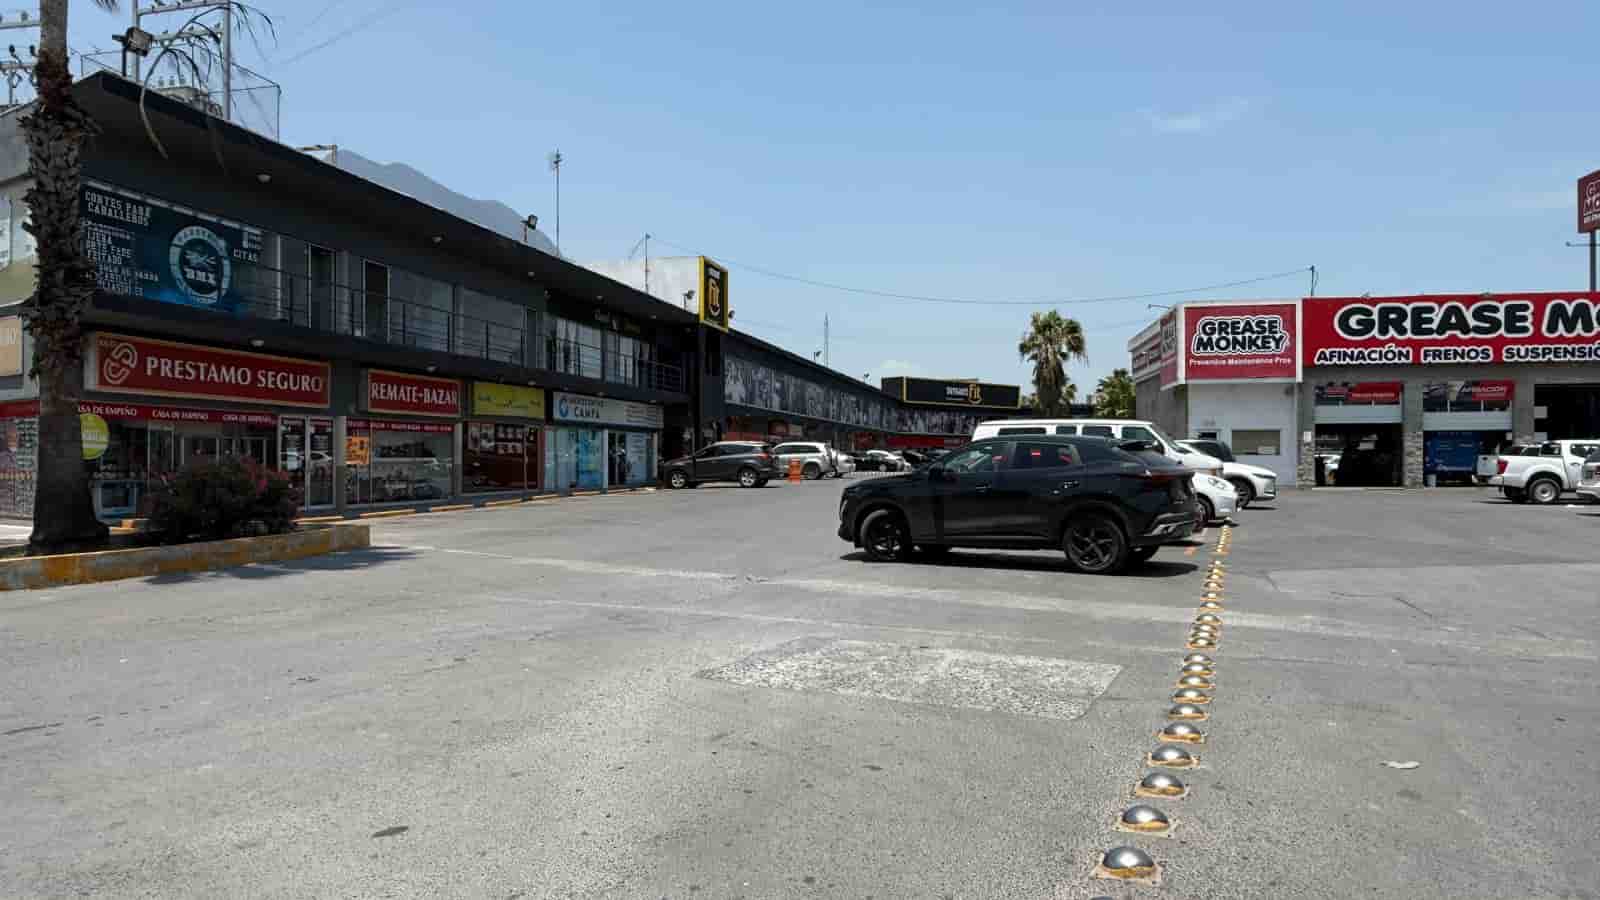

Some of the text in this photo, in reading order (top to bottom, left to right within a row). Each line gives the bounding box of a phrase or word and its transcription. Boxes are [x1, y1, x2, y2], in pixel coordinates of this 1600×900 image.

[85, 191, 122, 210] CORTES
[87, 202, 150, 226] CABALLEROS
[1337, 299, 1600, 338] GREASE M
[1201, 319, 1280, 337] GREASE
[1194, 334, 1284, 352] MONKEY
[1316, 345, 1410, 363] AFINACIÓN
[1422, 347, 1491, 362] FRENOS
[145, 356, 323, 393] PRESTAMO SEGURO
[370, 382, 457, 406] REMATE-BAZAR
[93, 406, 105, 415] DE
[105, 406, 137, 417] EMPEÑO
[152, 408, 171, 419] CASA
